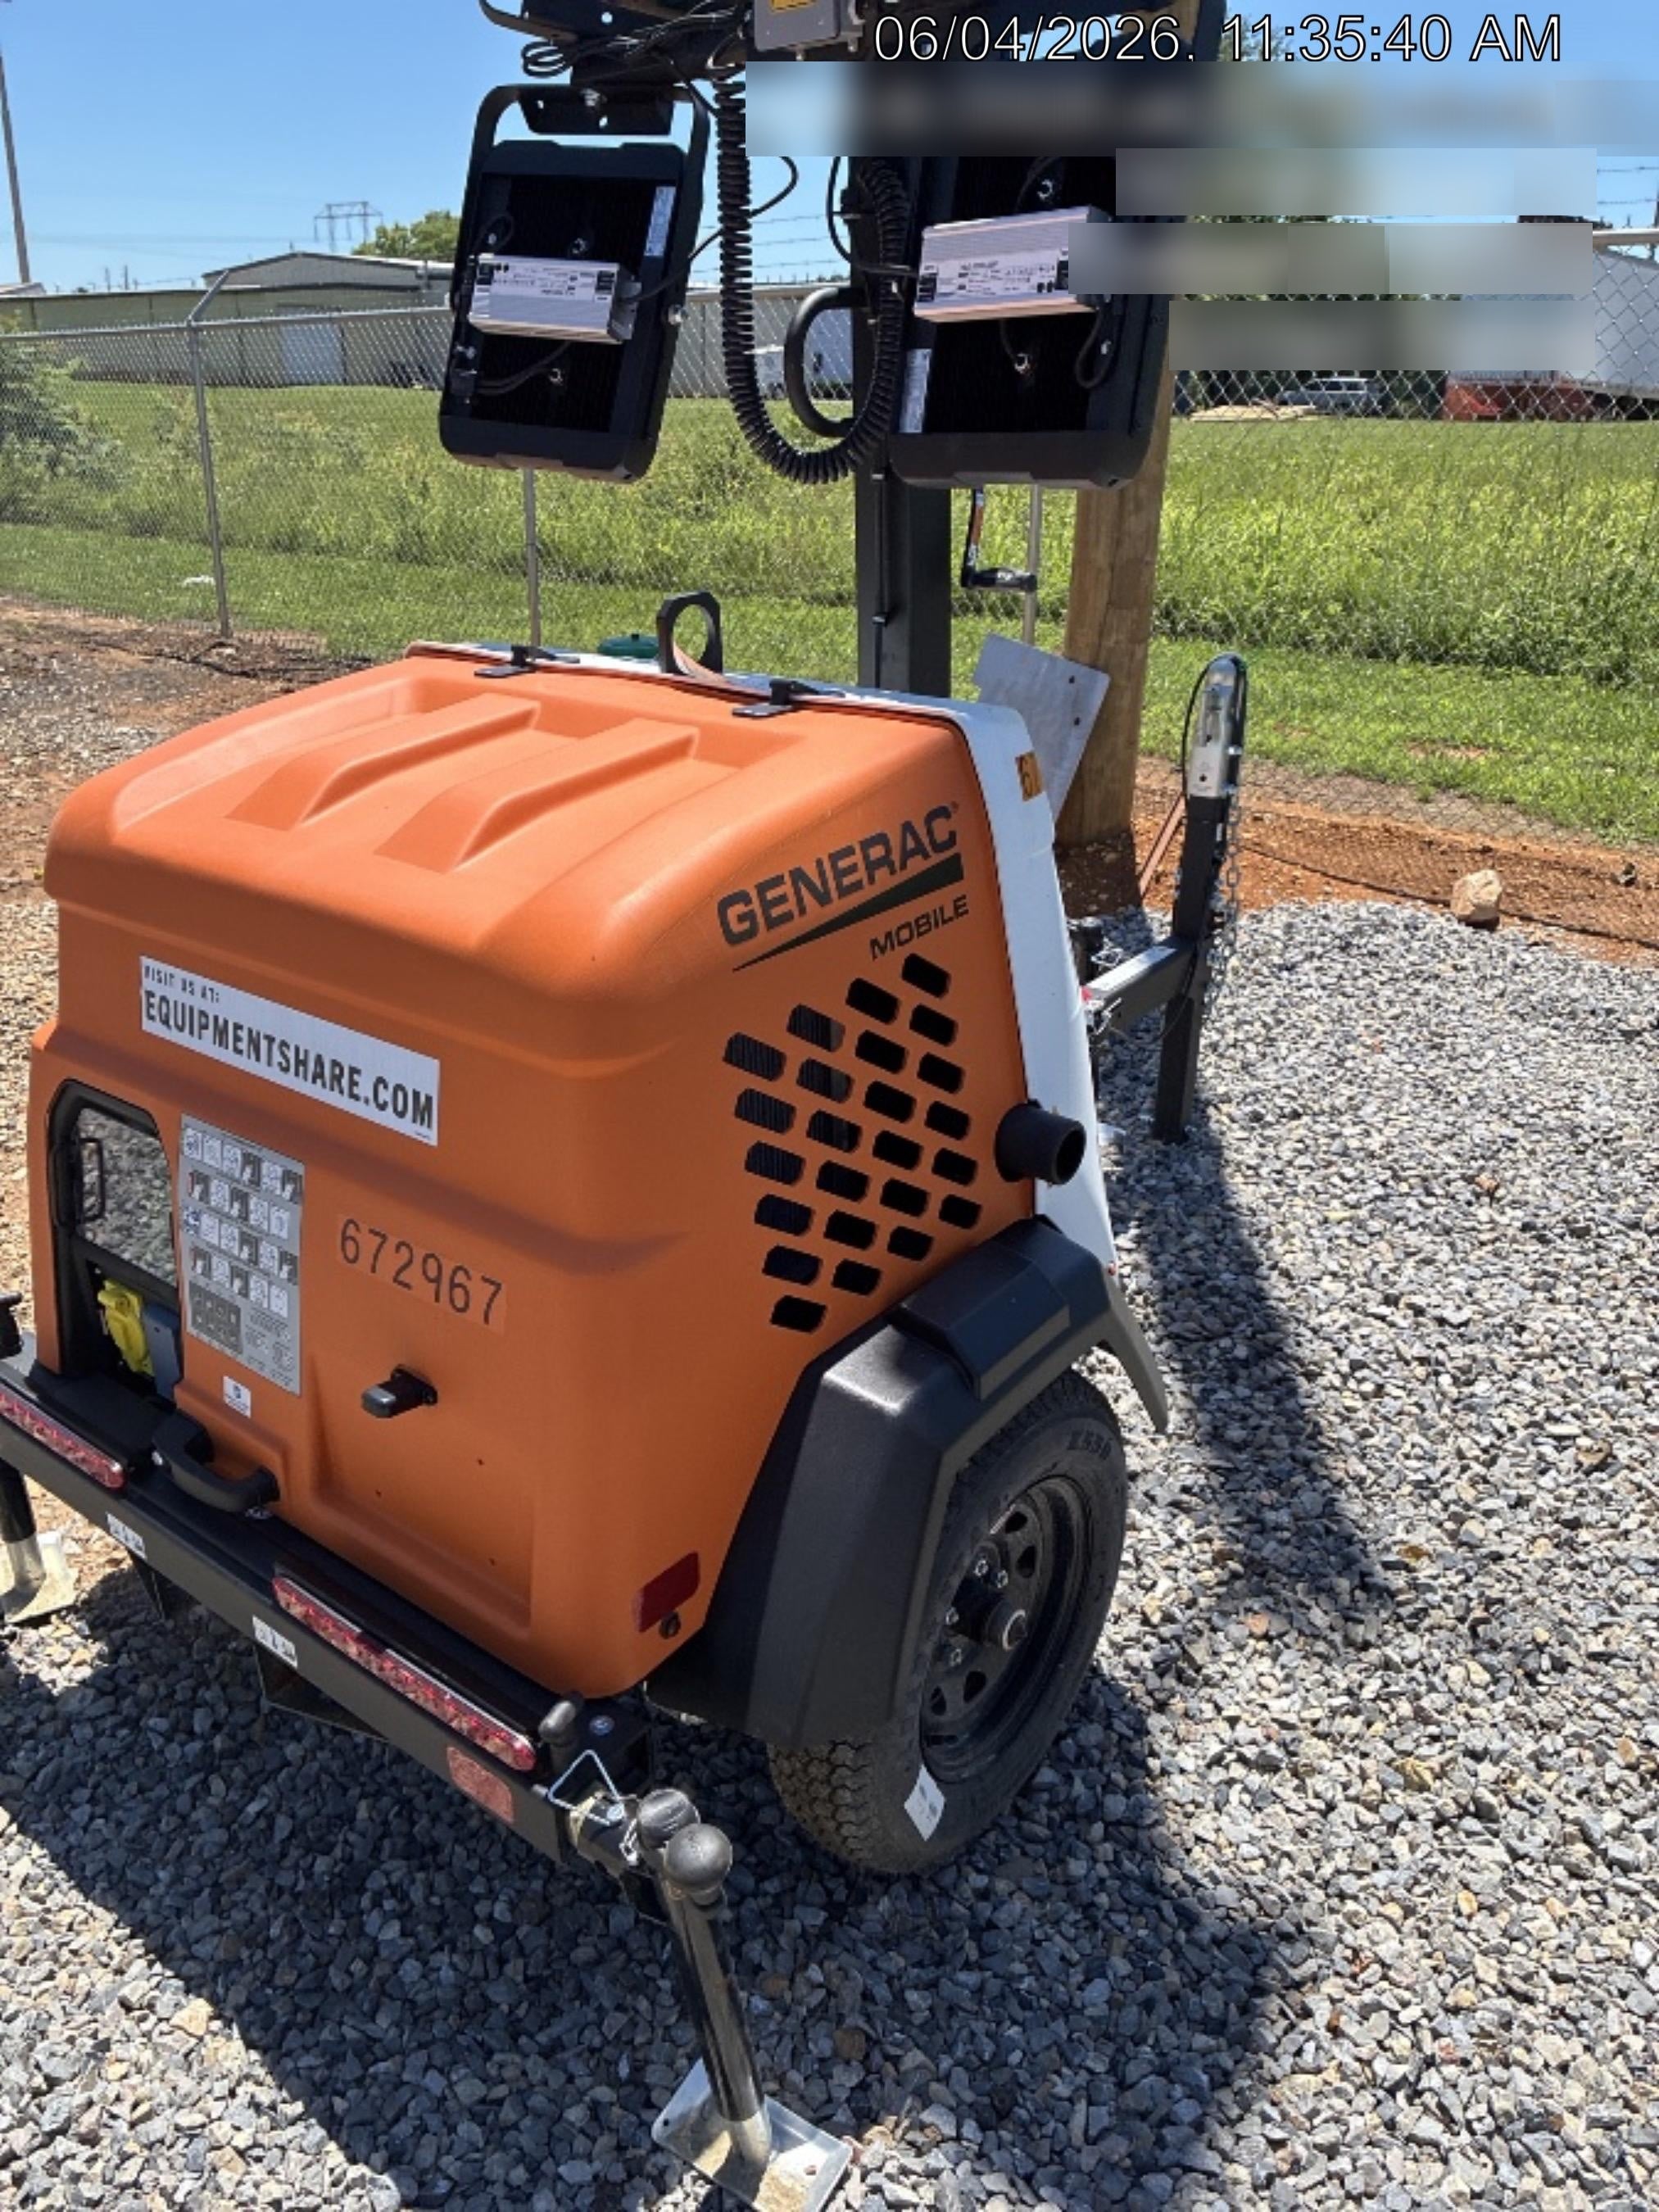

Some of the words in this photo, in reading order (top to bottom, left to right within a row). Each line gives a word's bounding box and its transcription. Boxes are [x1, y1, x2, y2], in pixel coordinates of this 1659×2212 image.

[717, 805, 958, 945] GENERAC
[869, 894, 969, 960] MOBILE
[144, 990, 433, 1130] EQUIPMENTSHARE.COM
[339, 1218, 502, 1325] 672967
